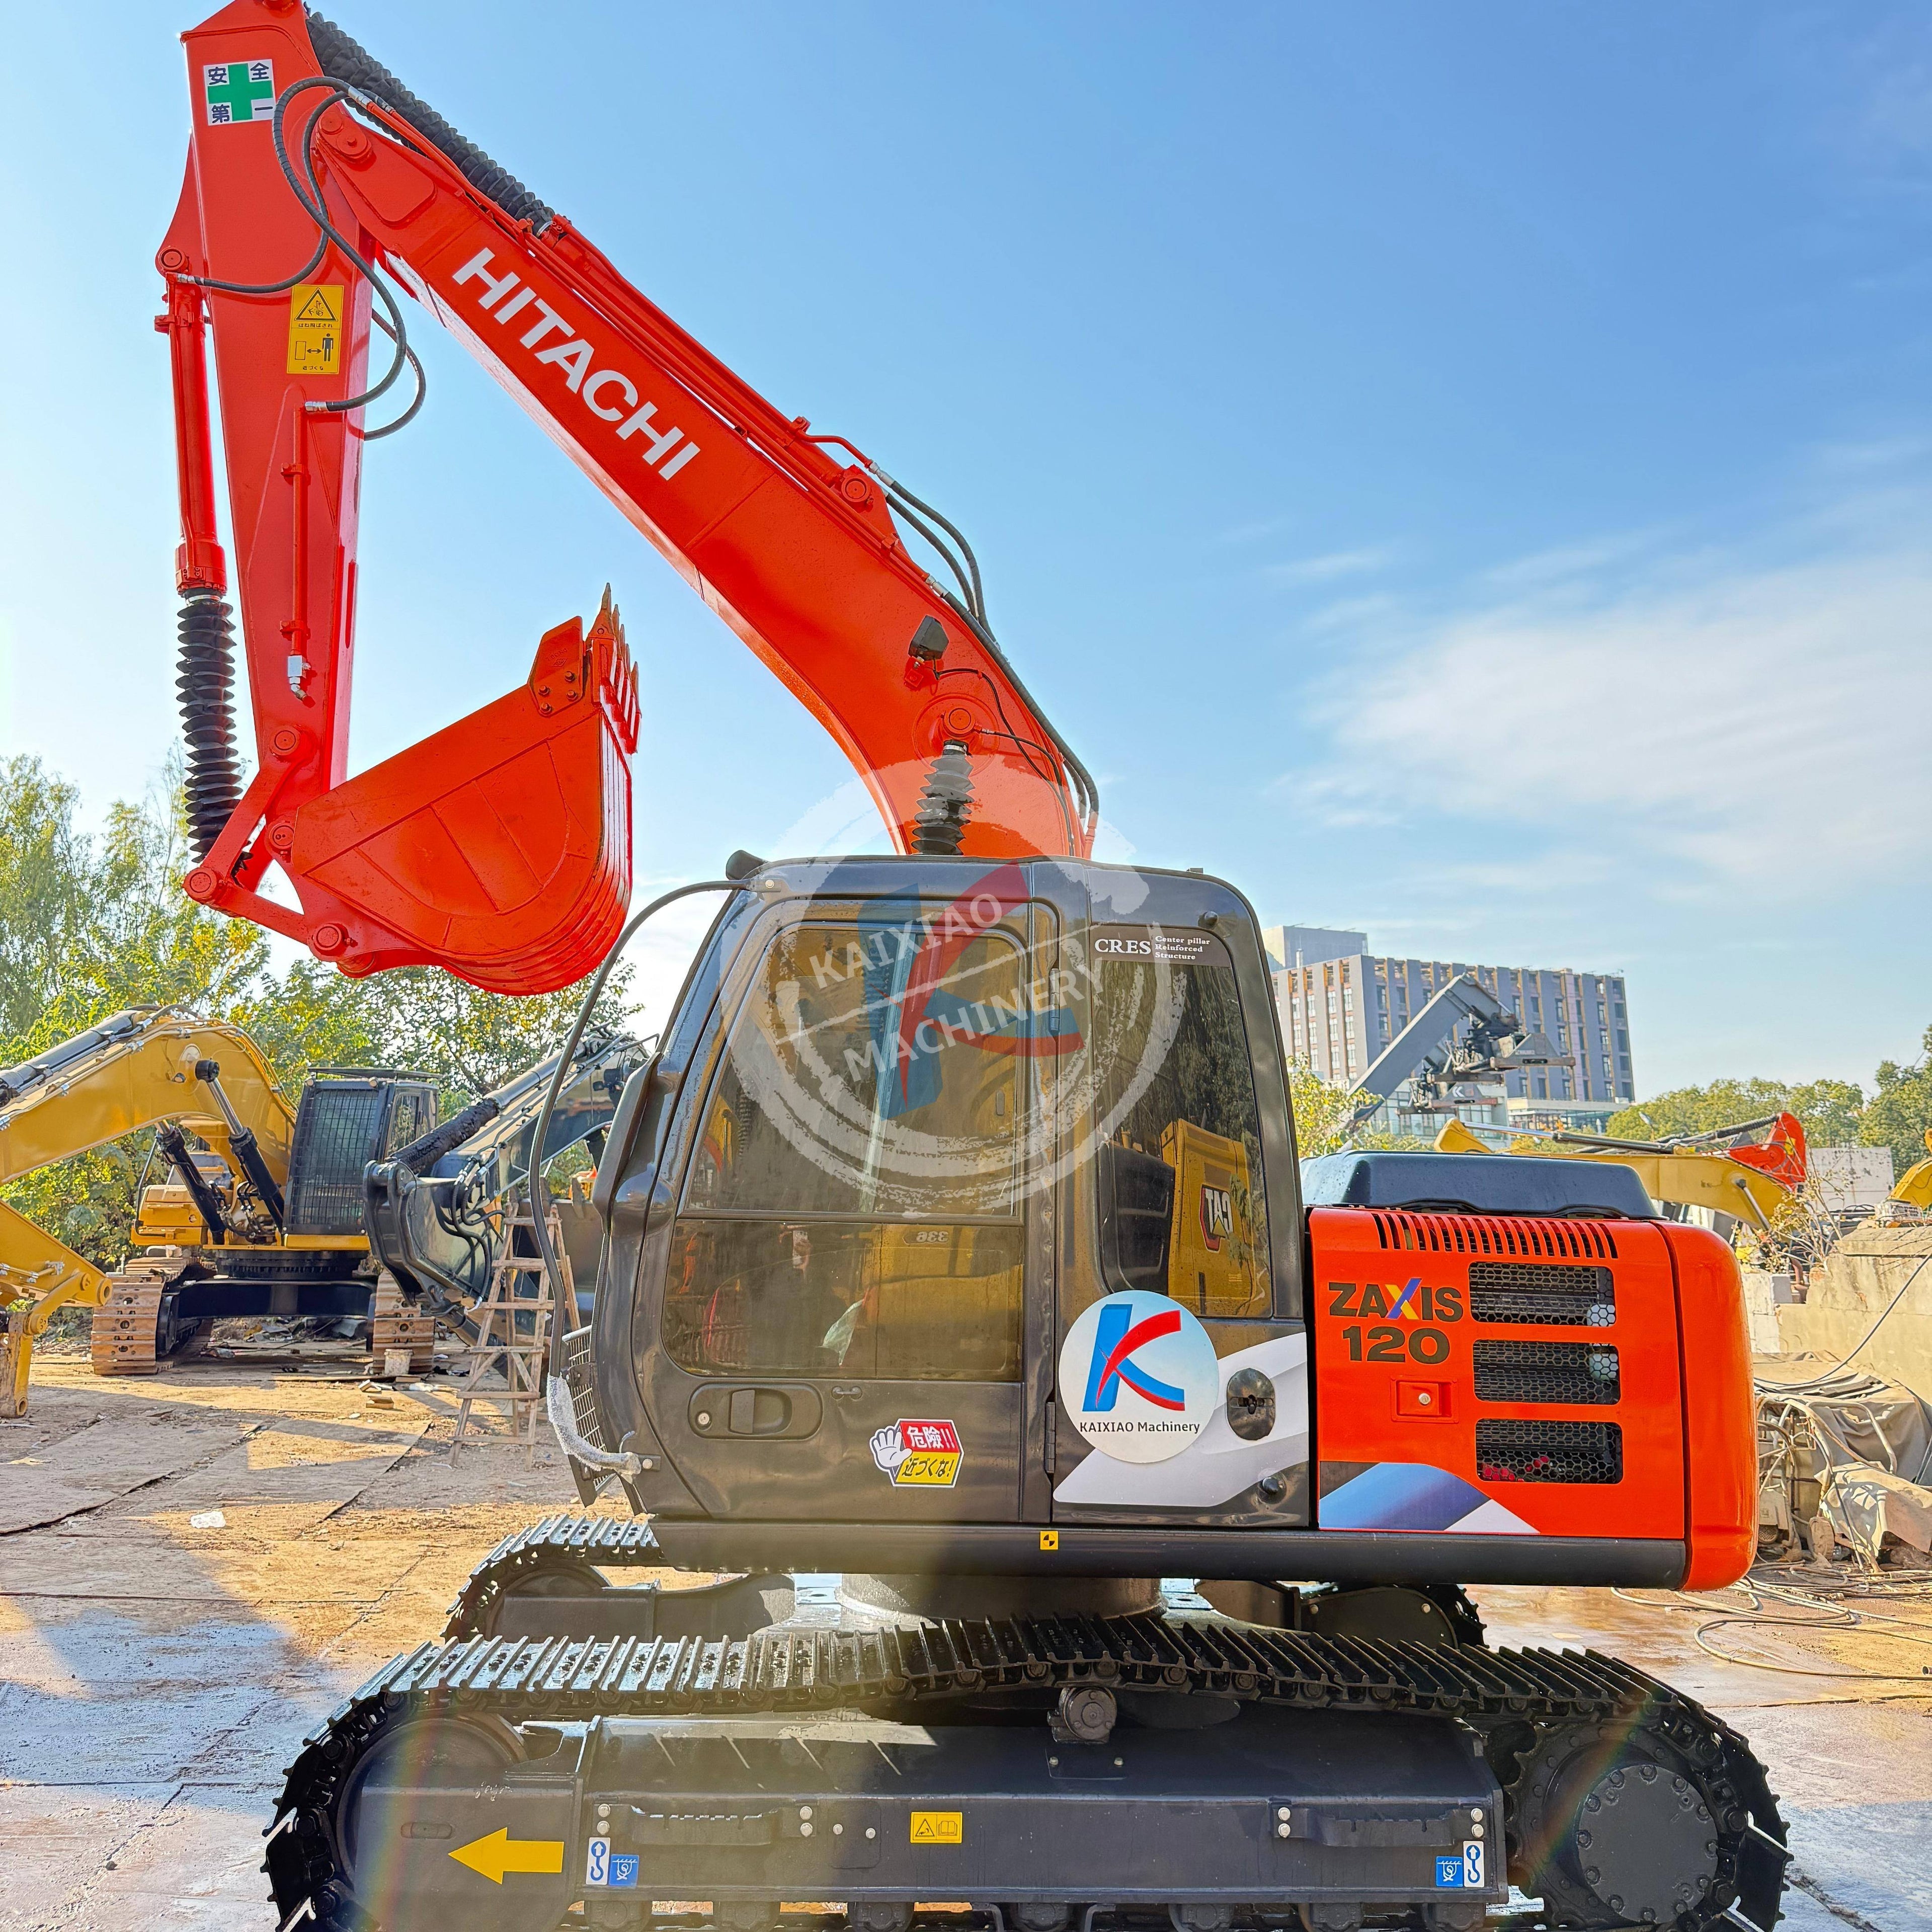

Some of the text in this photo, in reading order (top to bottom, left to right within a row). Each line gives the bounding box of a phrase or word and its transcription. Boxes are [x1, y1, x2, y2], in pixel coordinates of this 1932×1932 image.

[452, 247, 700, 480] HITACHI
[1094, 939, 1151, 954] CRES
[1155, 944, 1203, 952] Reinforced
[1329, 1278, 1463, 1322] ZAXIS
[1342, 1325, 1450, 1364] 120
[1080, 1421, 1200, 1434] KAIXIAO Machinery
